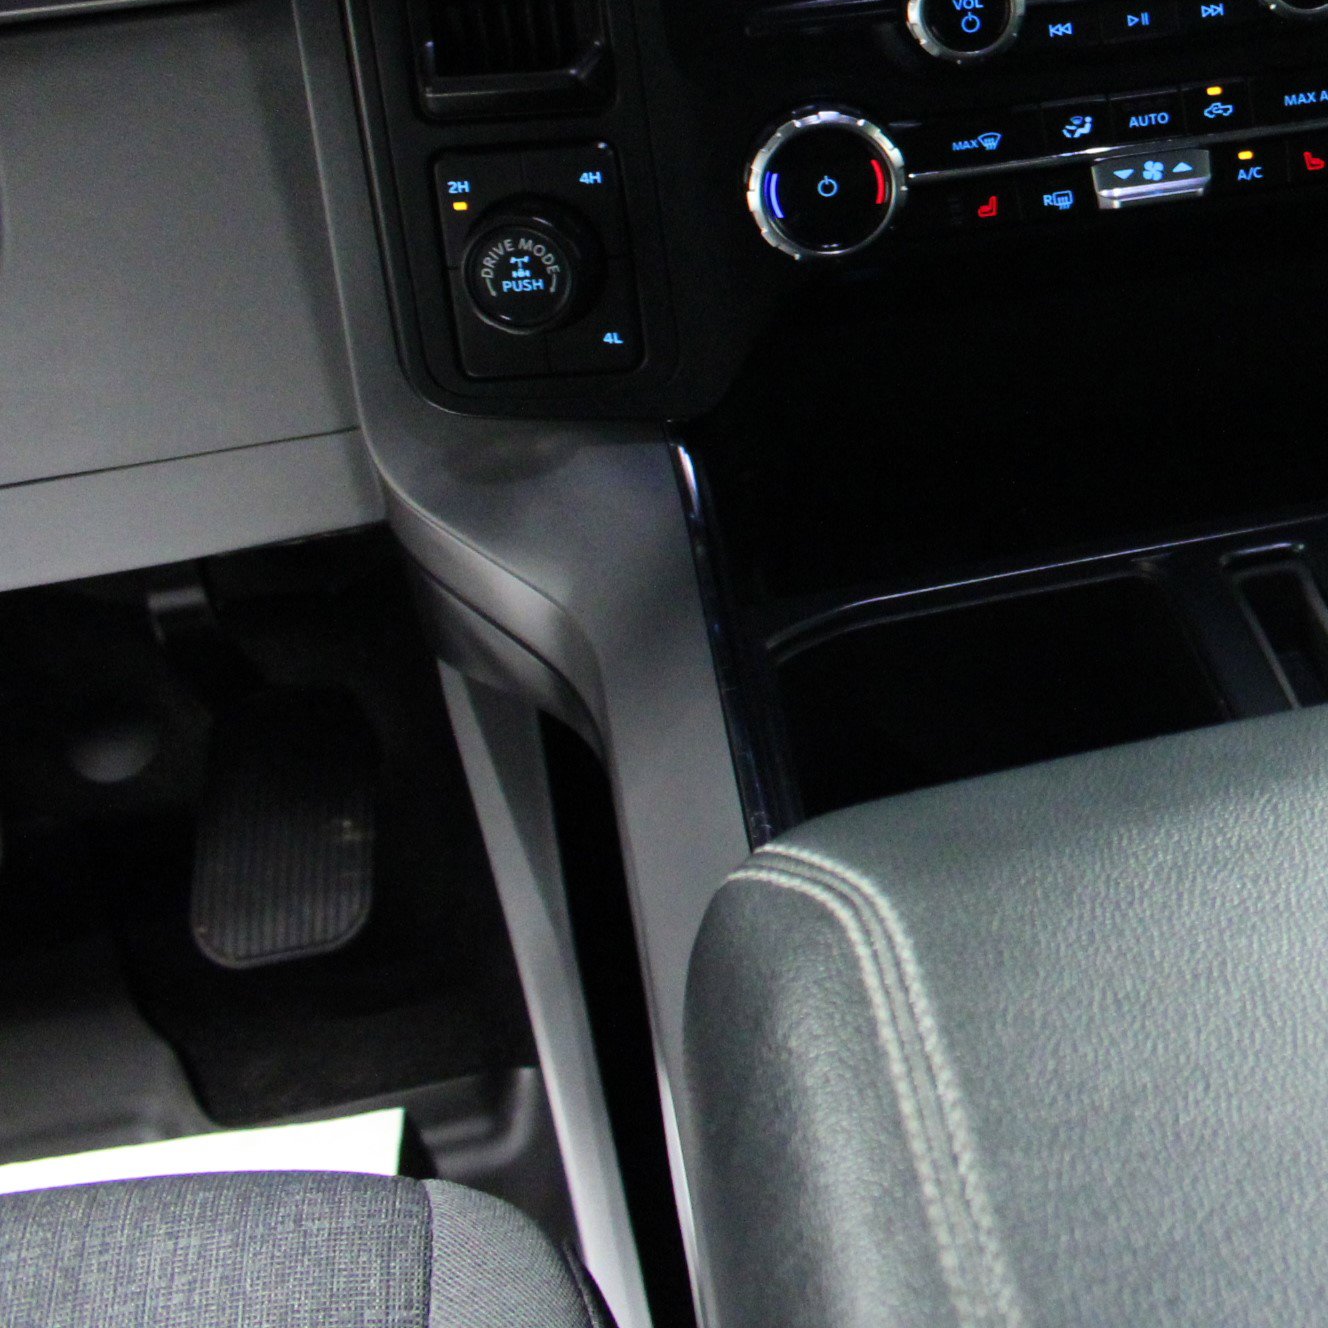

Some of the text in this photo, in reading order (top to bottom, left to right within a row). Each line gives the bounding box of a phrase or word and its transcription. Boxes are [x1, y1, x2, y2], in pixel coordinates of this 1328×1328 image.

[1283, 91, 1316, 107] MAX
[1128, 111, 1170, 128] AUTO
[952, 138, 978, 152] MAX
[579, 172, 602, 185] 4H
[1237, 166, 1264, 181] A/C
[447, 180, 471, 194] 2H
[1043, 194, 1053, 206] R
[481, 237, 561, 279] DRIVE MODE
[502, 278, 545, 293] PUSH
[603, 332, 624, 345] 4L
